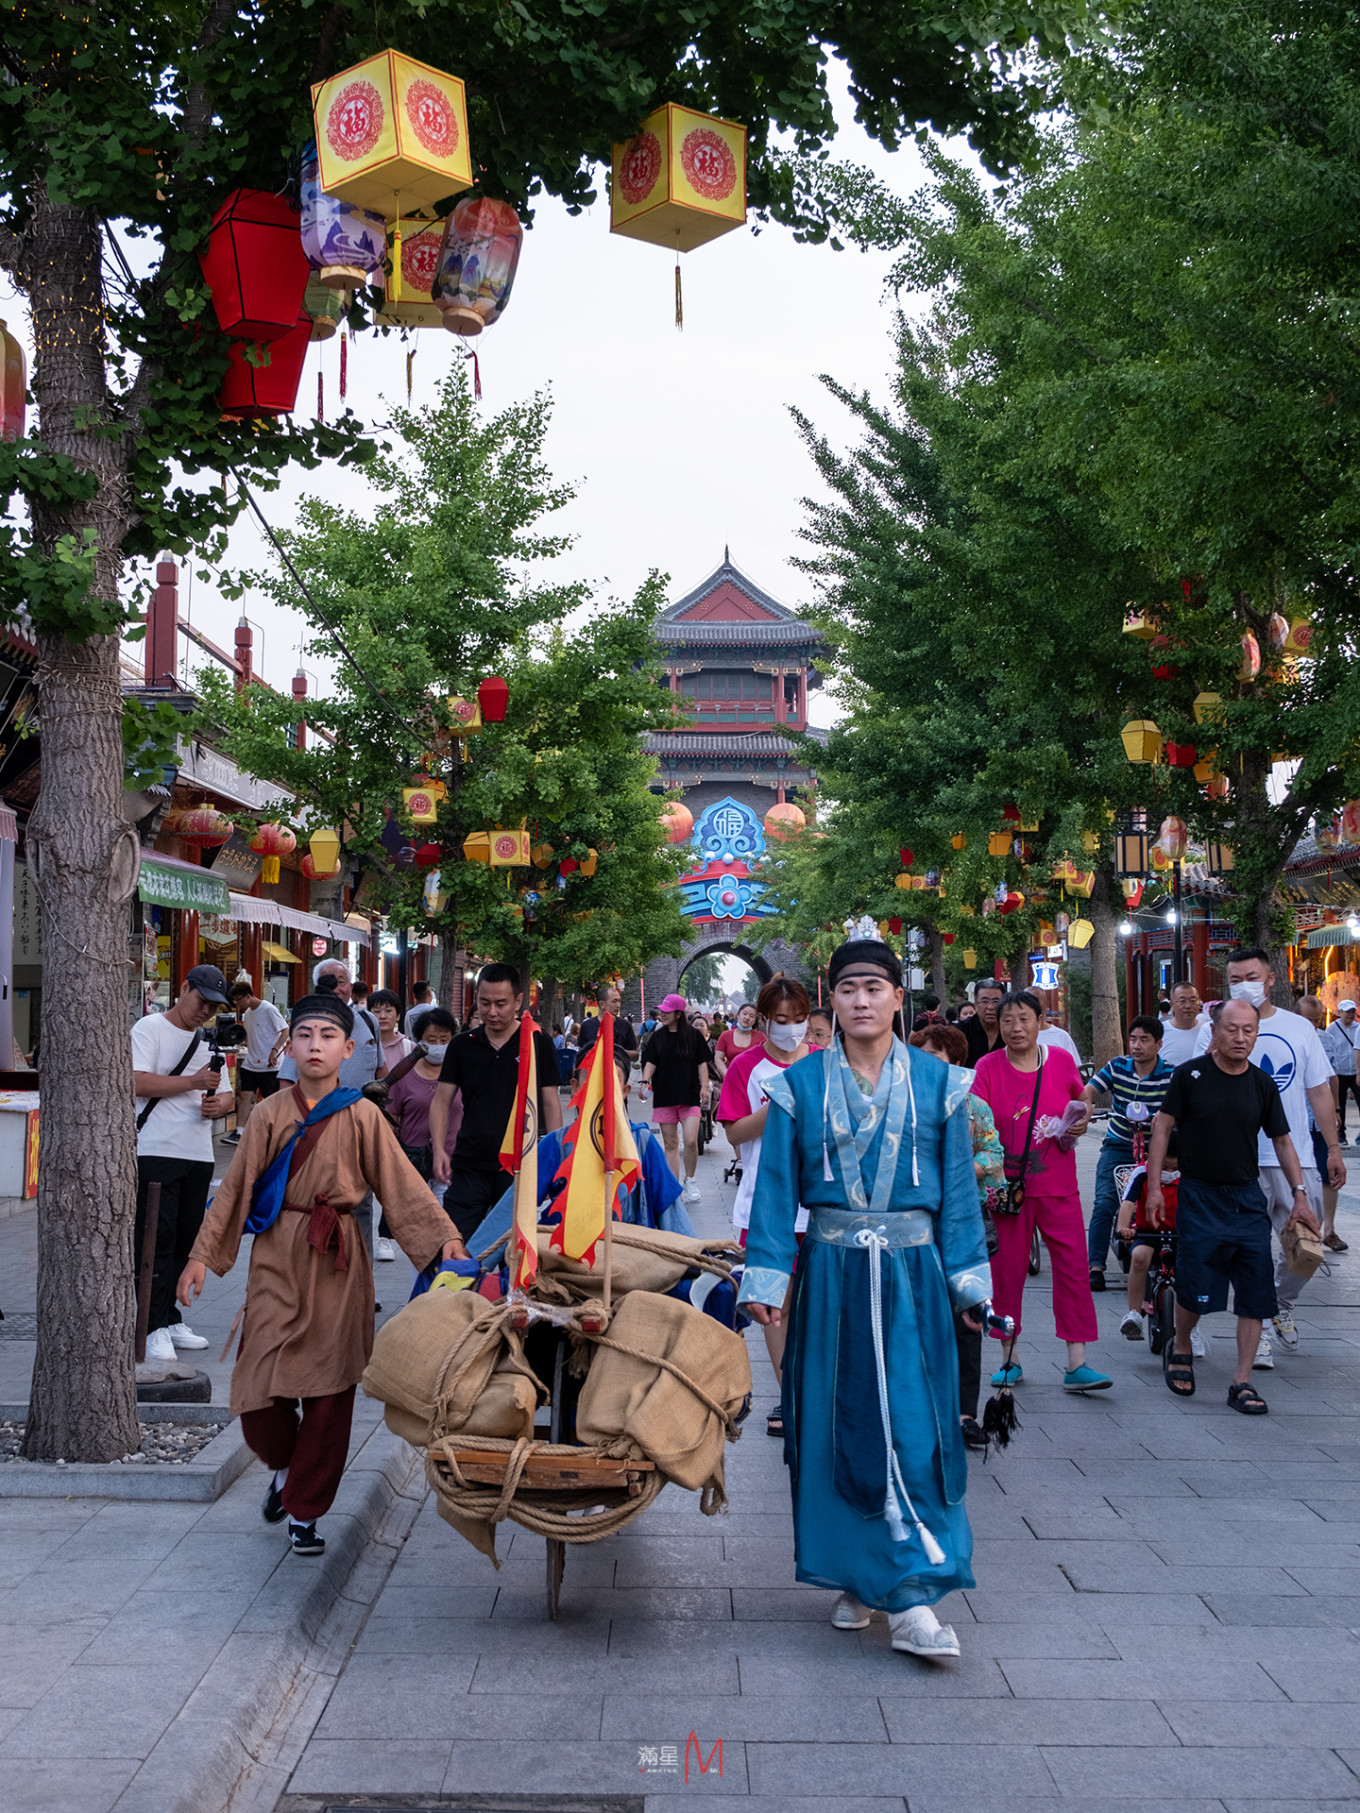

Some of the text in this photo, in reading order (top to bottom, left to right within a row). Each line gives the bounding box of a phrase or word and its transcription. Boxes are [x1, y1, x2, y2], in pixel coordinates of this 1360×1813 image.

[343, 105, 366, 137] 福
[423, 103, 443, 133] 福
[631, 153, 647, 182] 福
[698, 149, 720, 178] 福
[416, 249, 438, 273] 福
[713, 807, 745, 840] 福
